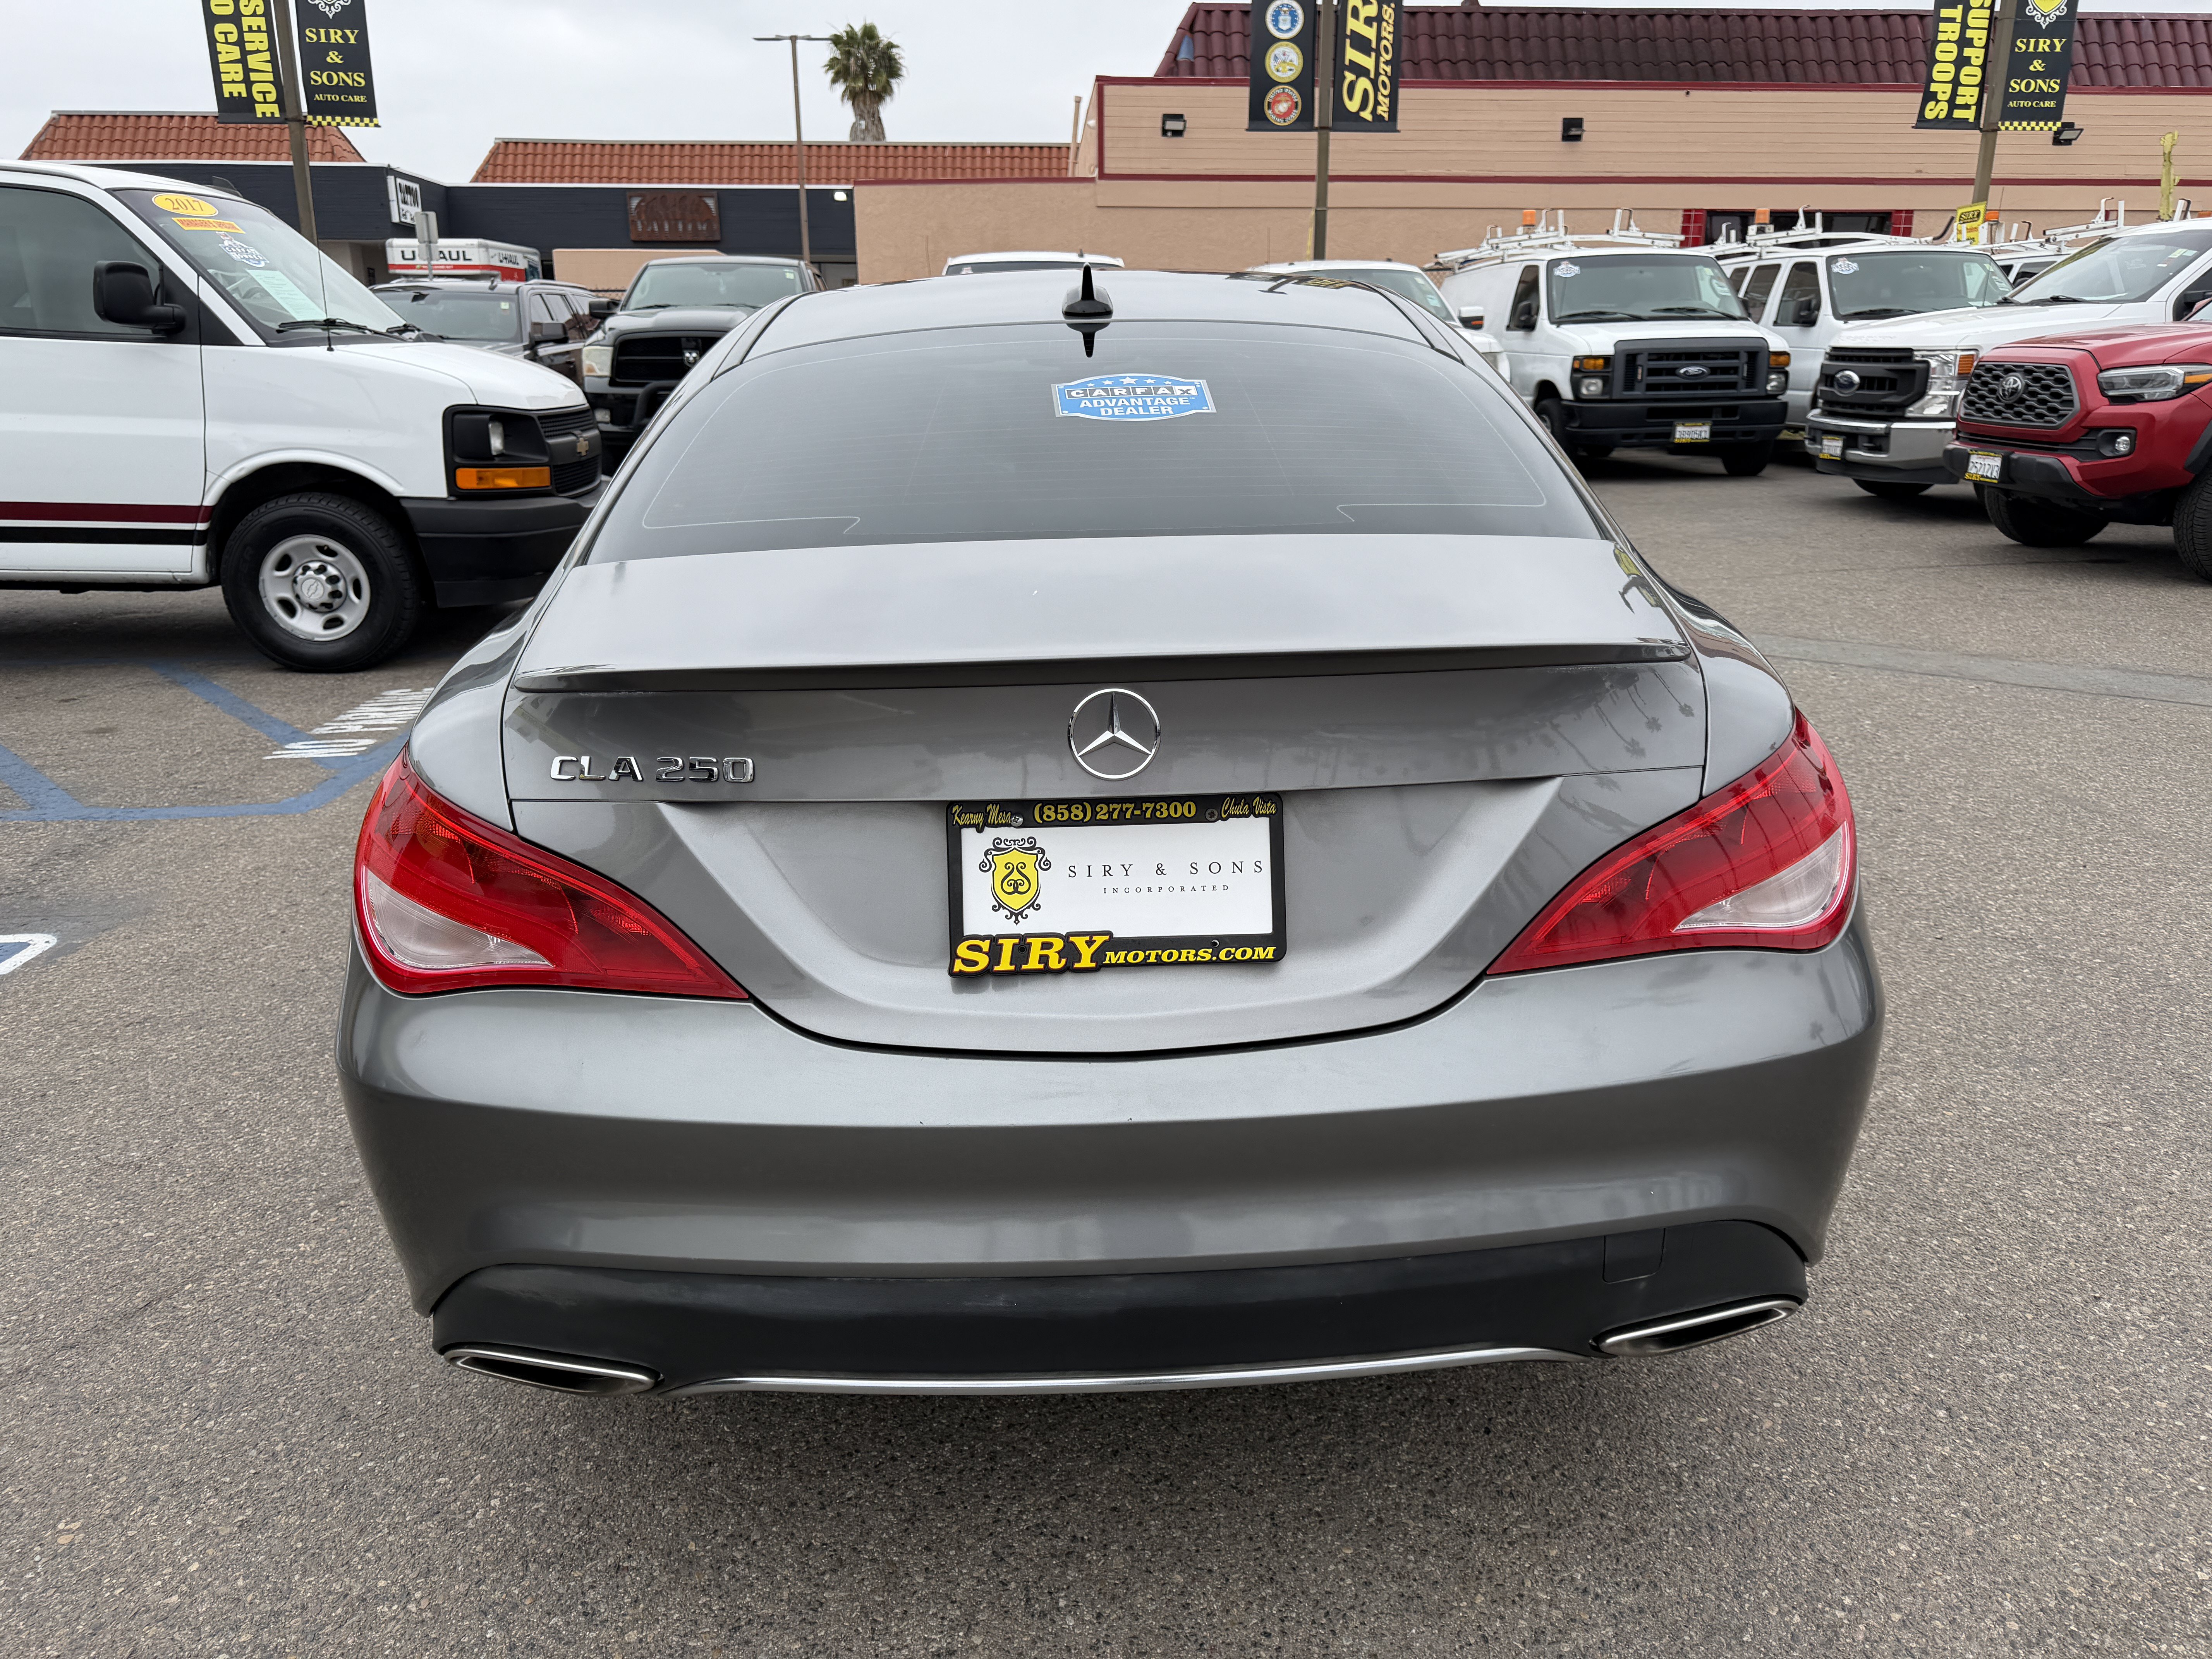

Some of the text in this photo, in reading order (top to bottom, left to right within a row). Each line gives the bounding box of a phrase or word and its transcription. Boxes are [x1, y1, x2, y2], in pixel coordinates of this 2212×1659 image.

[305, 28, 359, 44] SIRY
[2014, 38, 2067, 53] SIRY
[214, 23, 247, 97] CARE
[239, 0, 280, 117] SERVICE
[326, 51, 344, 64] &
[1924, 5, 1963, 119] TROOPS
[2029, 59, 2046, 71] &
[310, 71, 366, 87] SONS
[2009, 79, 2061, 93] SONS
[314, 93, 367, 103] AUTO CARE
[165, 198, 204, 211] 2017
[1070, 386, 1194, 398] CARFAX
[1079, 397, 1191, 407] ADVANTAGE
[1100, 406, 1174, 416] DEALER
[262, 738, 377, 760] NO
[550, 756, 755, 783] CLA 250
[1034, 801, 1196, 823] (858) 277-7300
[1221, 796, 1276, 818] Chula Vista
[952, 803, 1011, 830] Kearny Mesa
[1068, 860, 1263, 878] SIRY & SONS
[1103, 884, 1230, 894] INCORPORATED
[953, 934, 1276, 974] SIRY MOTORS.COM
